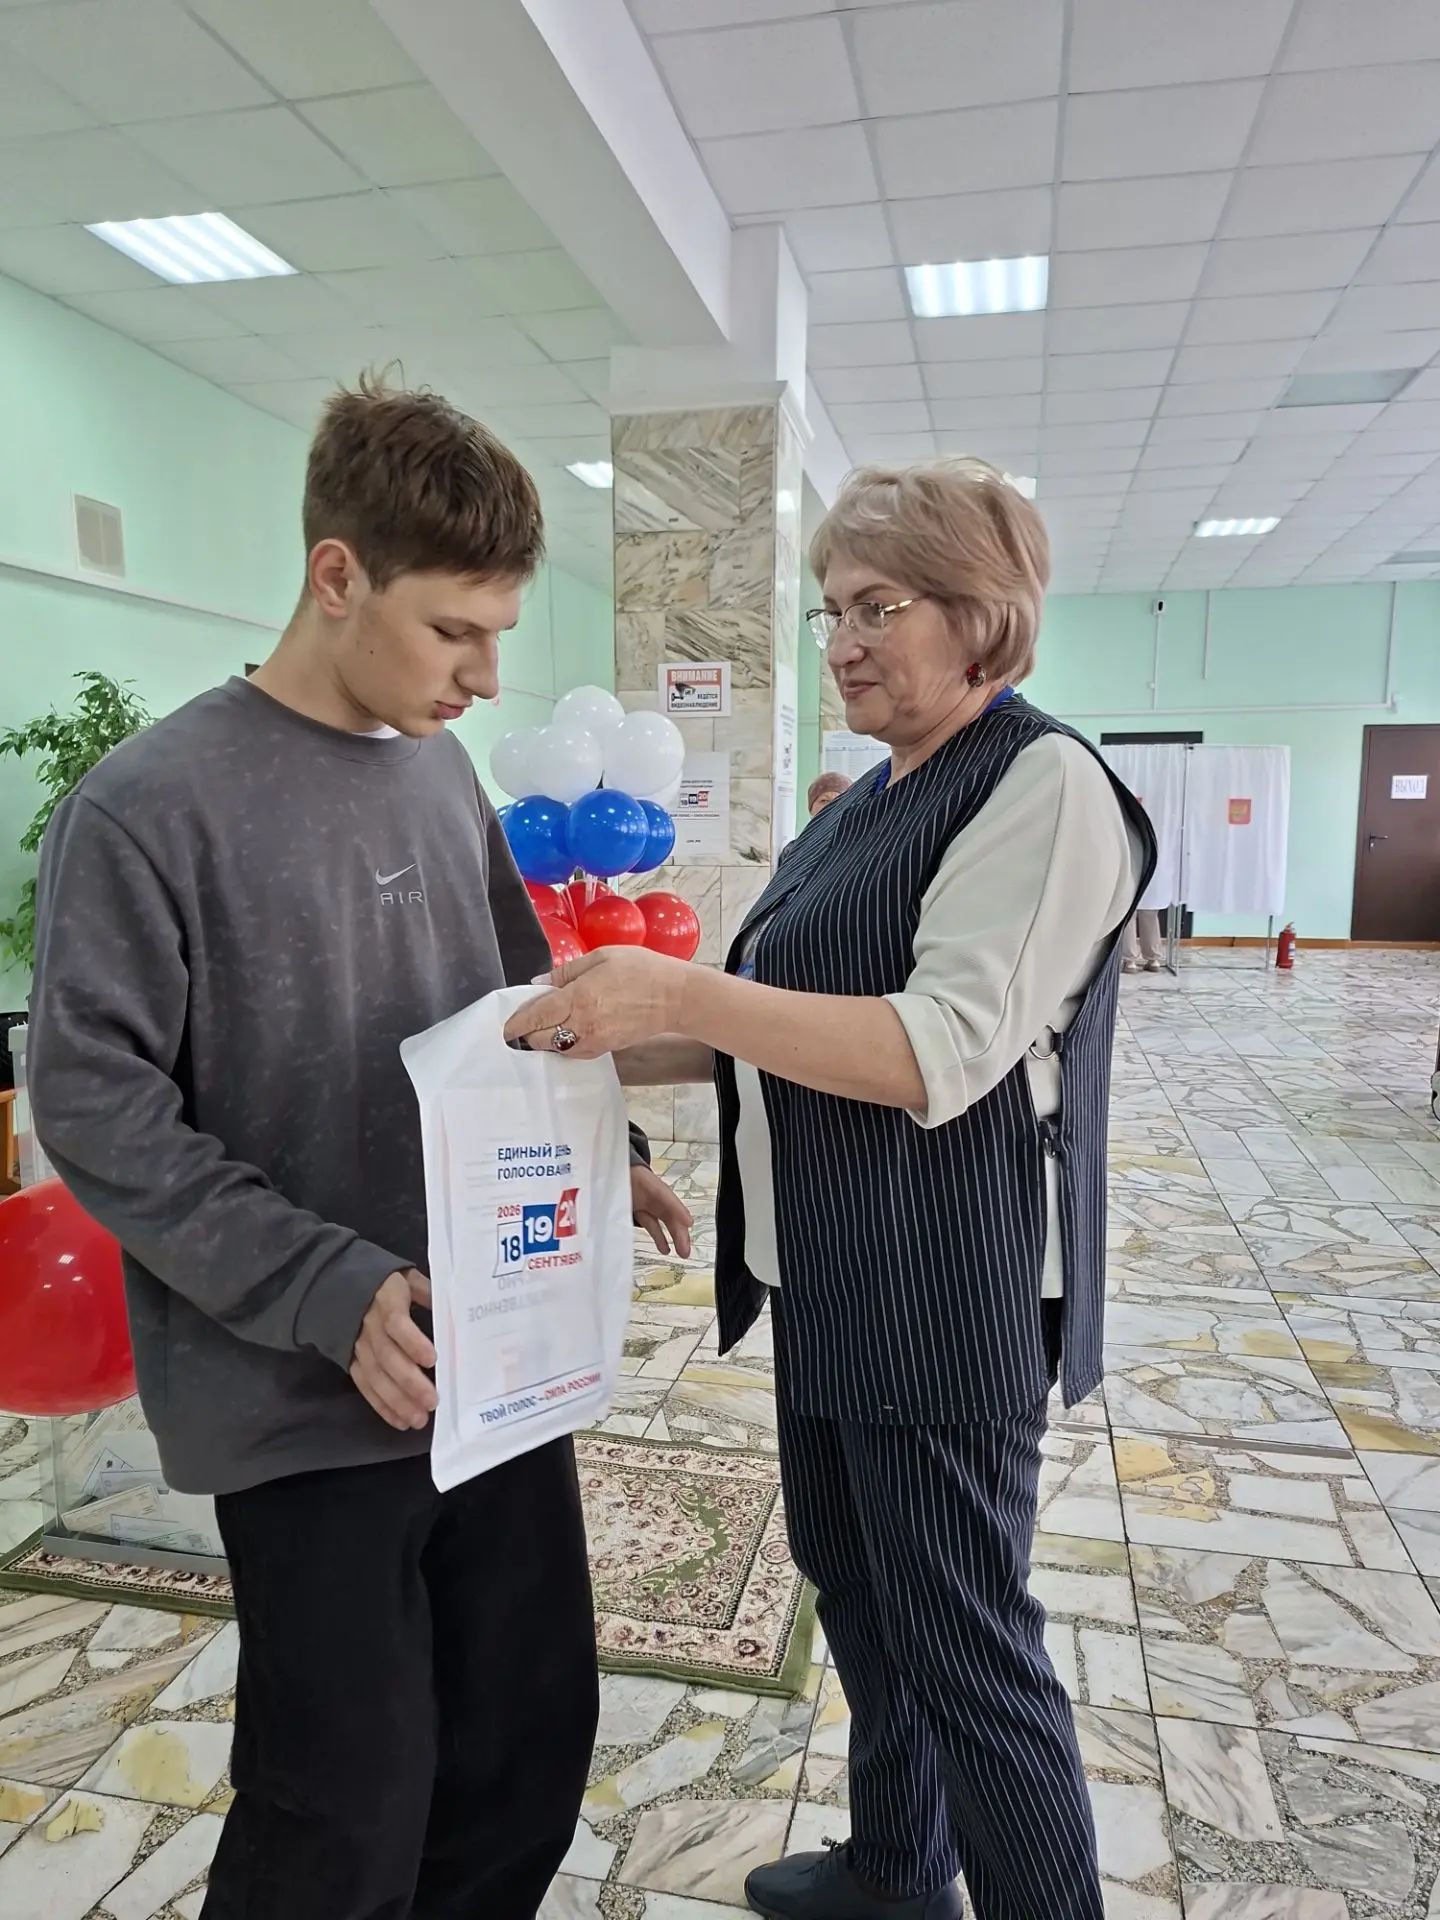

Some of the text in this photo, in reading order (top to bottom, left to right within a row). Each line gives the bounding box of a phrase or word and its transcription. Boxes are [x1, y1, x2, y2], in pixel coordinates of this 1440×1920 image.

[671, 670, 718, 681] ВНИМАНИЕ
[380, 891, 424, 906] AIR
[497, 1143, 552, 1162] ЕДИНЫЙ
[497, 1204, 521, 1219] 2026
[501, 1235, 521, 1264] 18
[525, 1215, 553, 1244] 19
